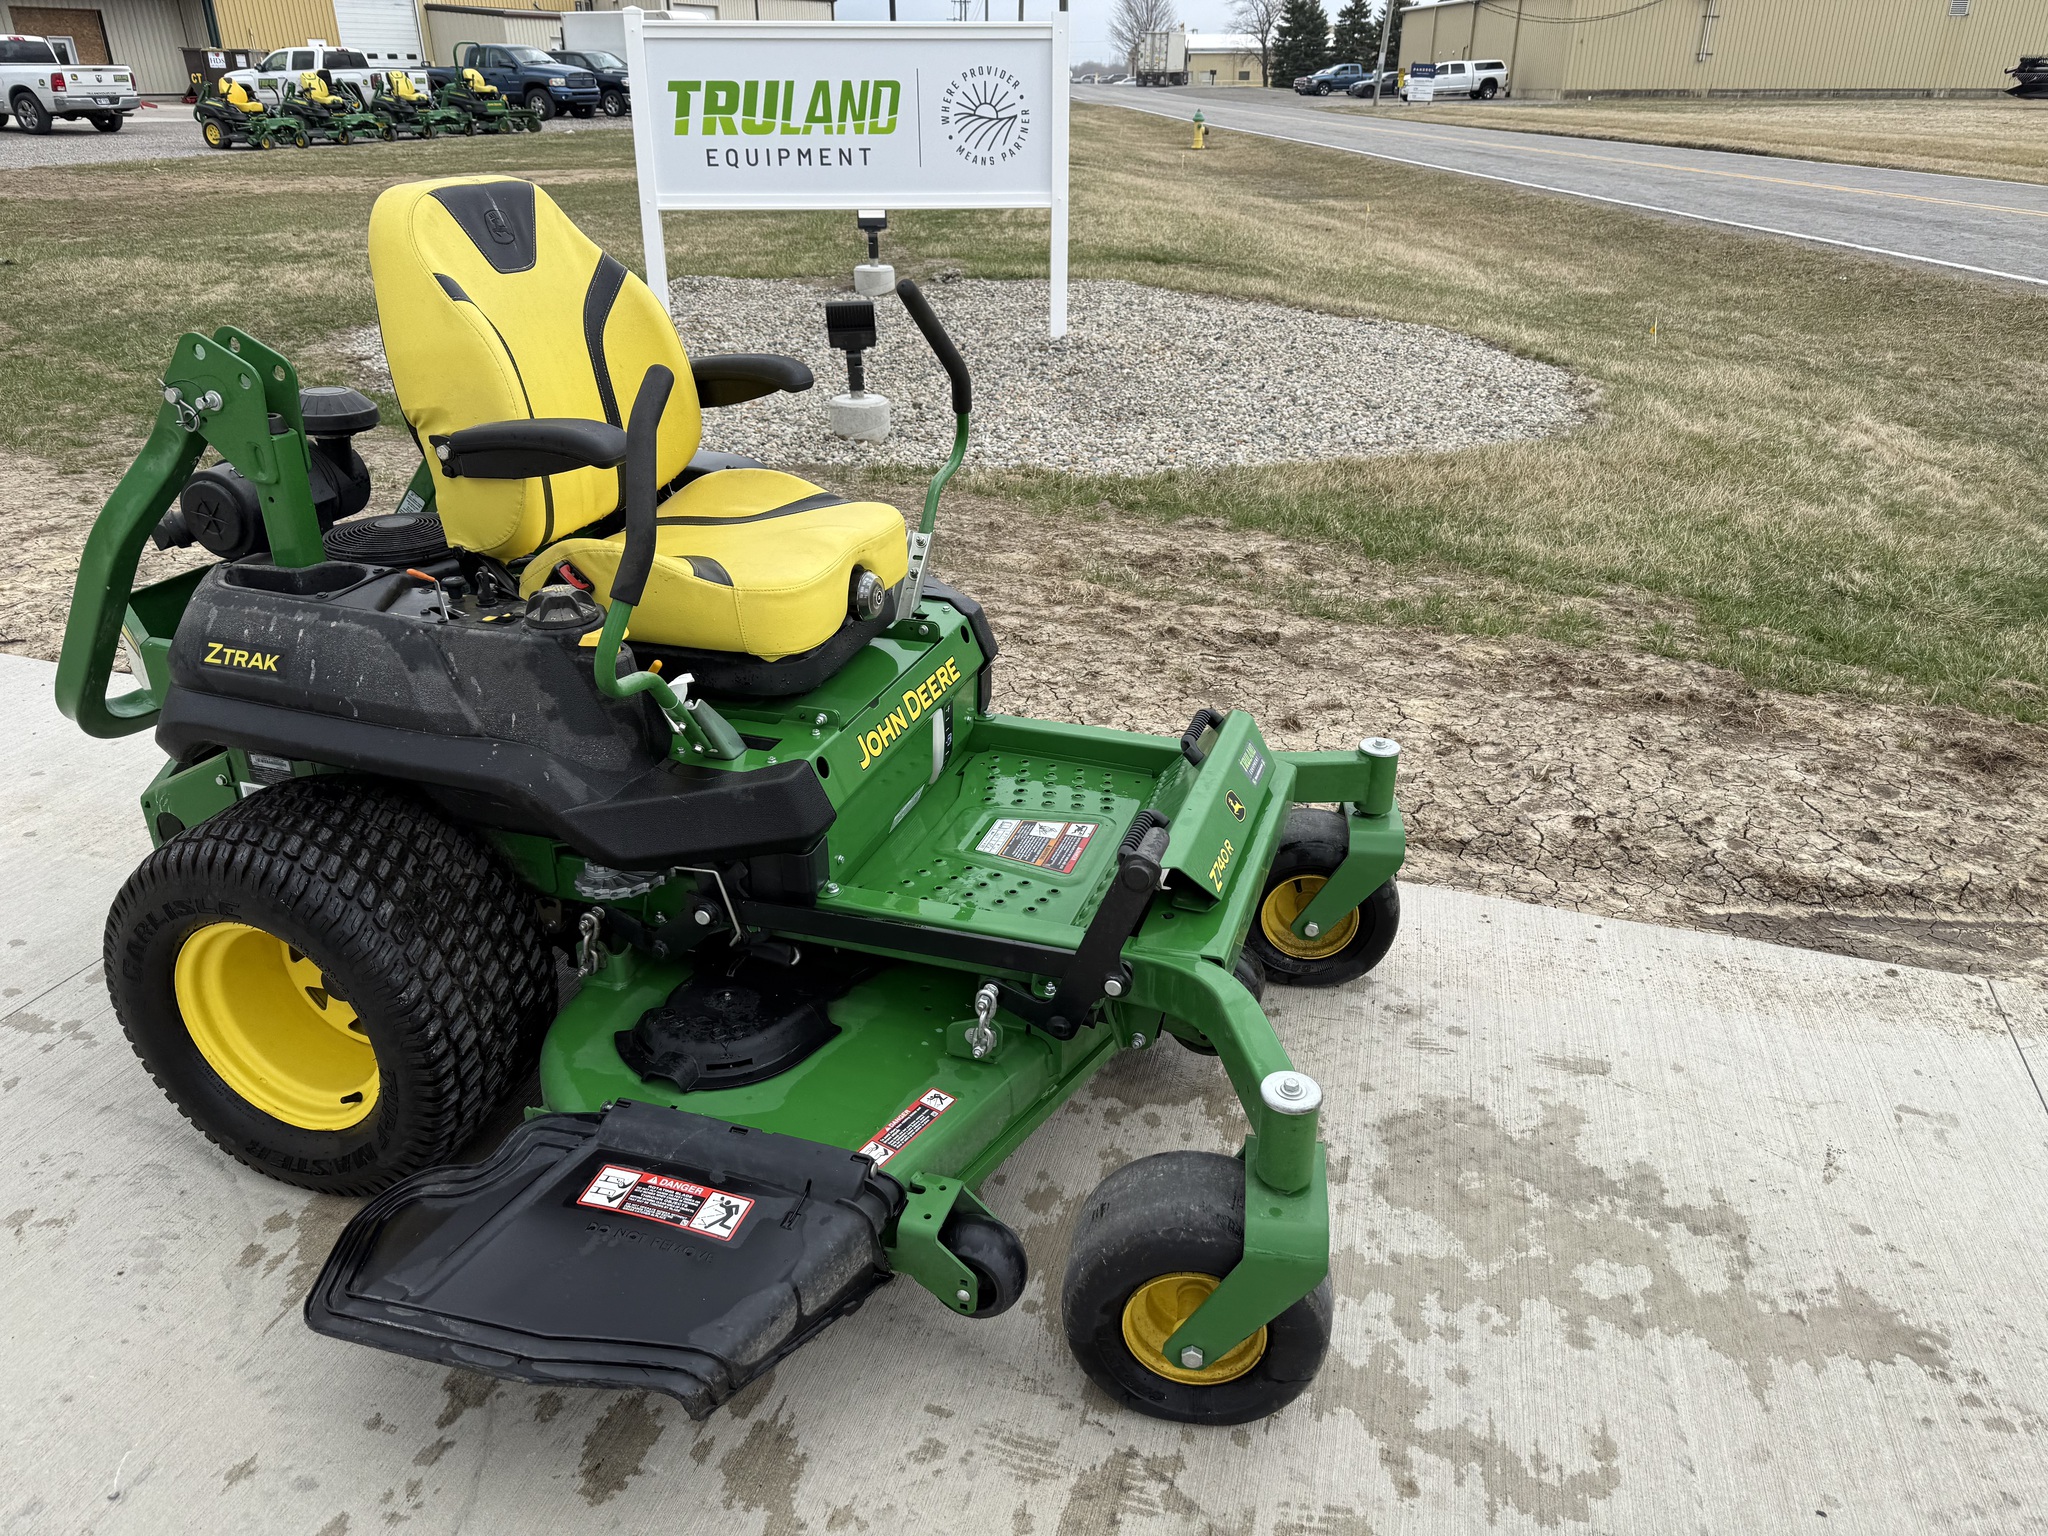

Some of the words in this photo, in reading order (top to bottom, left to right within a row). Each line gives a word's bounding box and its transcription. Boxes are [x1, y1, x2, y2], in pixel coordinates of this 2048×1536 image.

[191, 73, 203, 84] CT
[941, 80, 960, 125] WHERE
[961, 65, 1021, 90] PROVIDER
[667, 80, 901, 136] TRULAND
[706, 147, 871, 169] EQUIPMENT
[956, 145, 995, 166] MEANS
[1001, 109, 1030, 162] PARTNER
[204, 642, 280, 672] ZTRAK
[856, 705, 909, 770] JOHN
[902, 656, 961, 722] DEERE
[122, 898, 241, 985] CARLISLE
[245, 1139, 378, 1176] MASTER
[659, 1178, 704, 1195] DANGER
